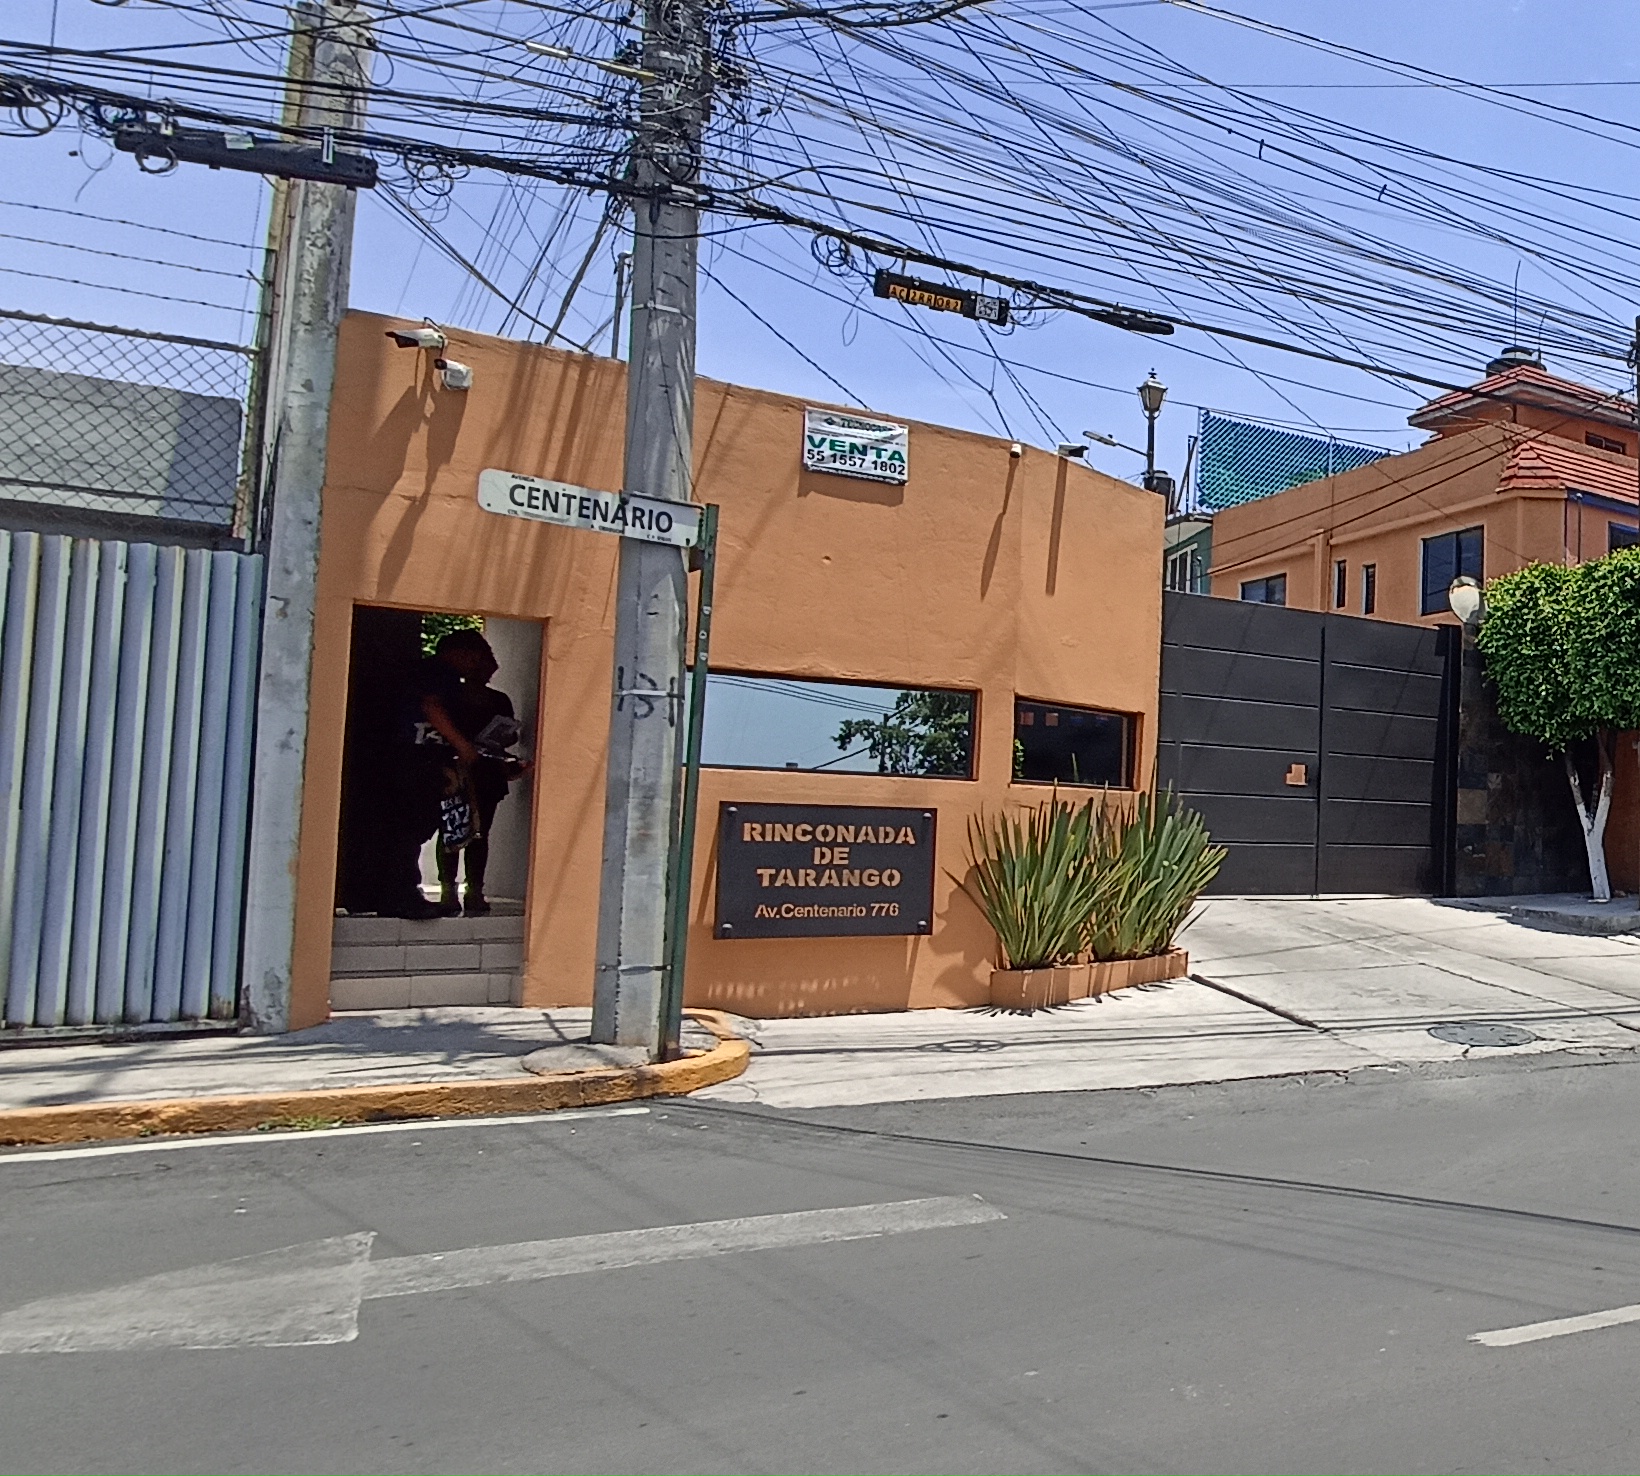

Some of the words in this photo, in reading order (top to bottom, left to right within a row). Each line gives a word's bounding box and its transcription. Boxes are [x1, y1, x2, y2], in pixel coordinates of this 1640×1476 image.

[807, 434, 906, 464] VENTA
[807, 448, 825, 461] 55
[830, 452, 866, 468] 1557
[871, 460, 905, 476] 1802
[509, 483, 674, 534] CENTENARIO
[742, 822, 916, 845] RINCONADA
[813, 846, 850, 865] DE
[756, 868, 902, 887] TARANGO
[870, 903, 899, 917] 776
